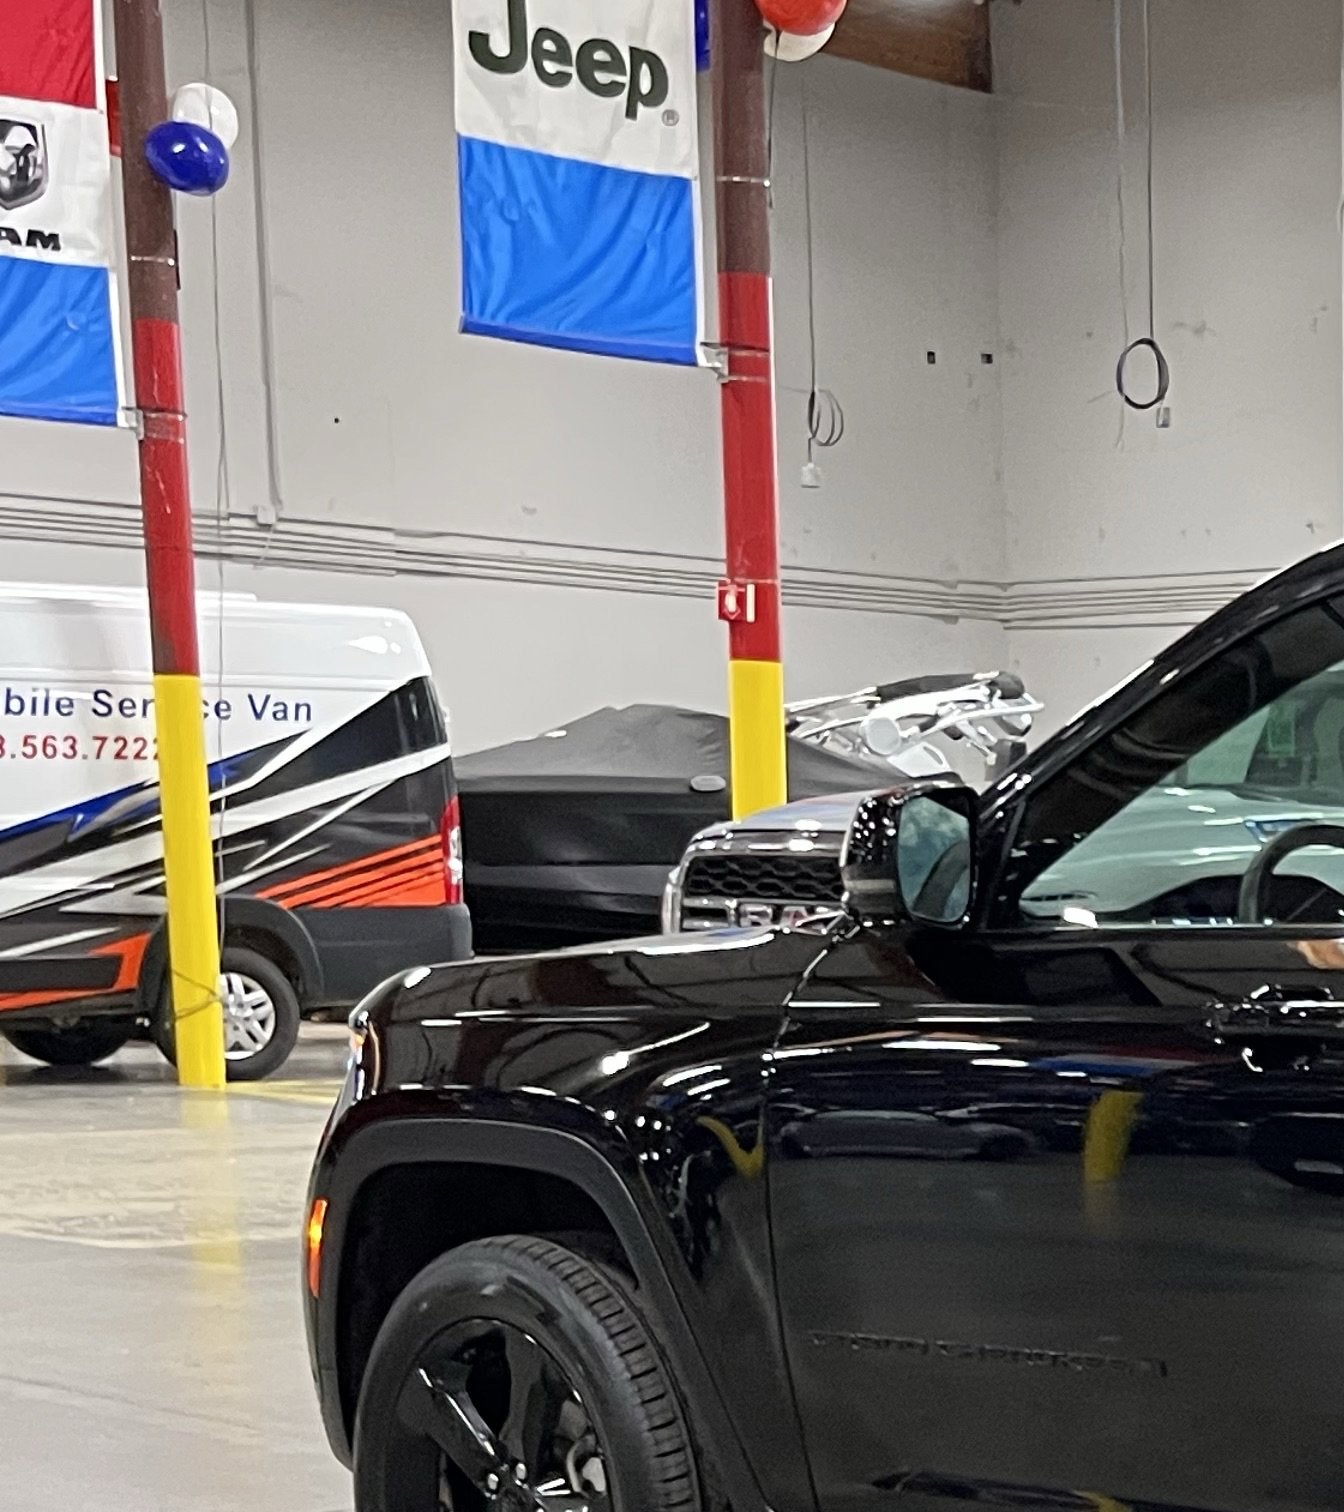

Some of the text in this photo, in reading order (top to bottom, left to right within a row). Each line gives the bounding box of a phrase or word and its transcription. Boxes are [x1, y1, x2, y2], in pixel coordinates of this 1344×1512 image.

[468, 0, 669, 121] Jeep
[91, 689, 232, 721] Sere
[247, 694, 312, 722] Van
